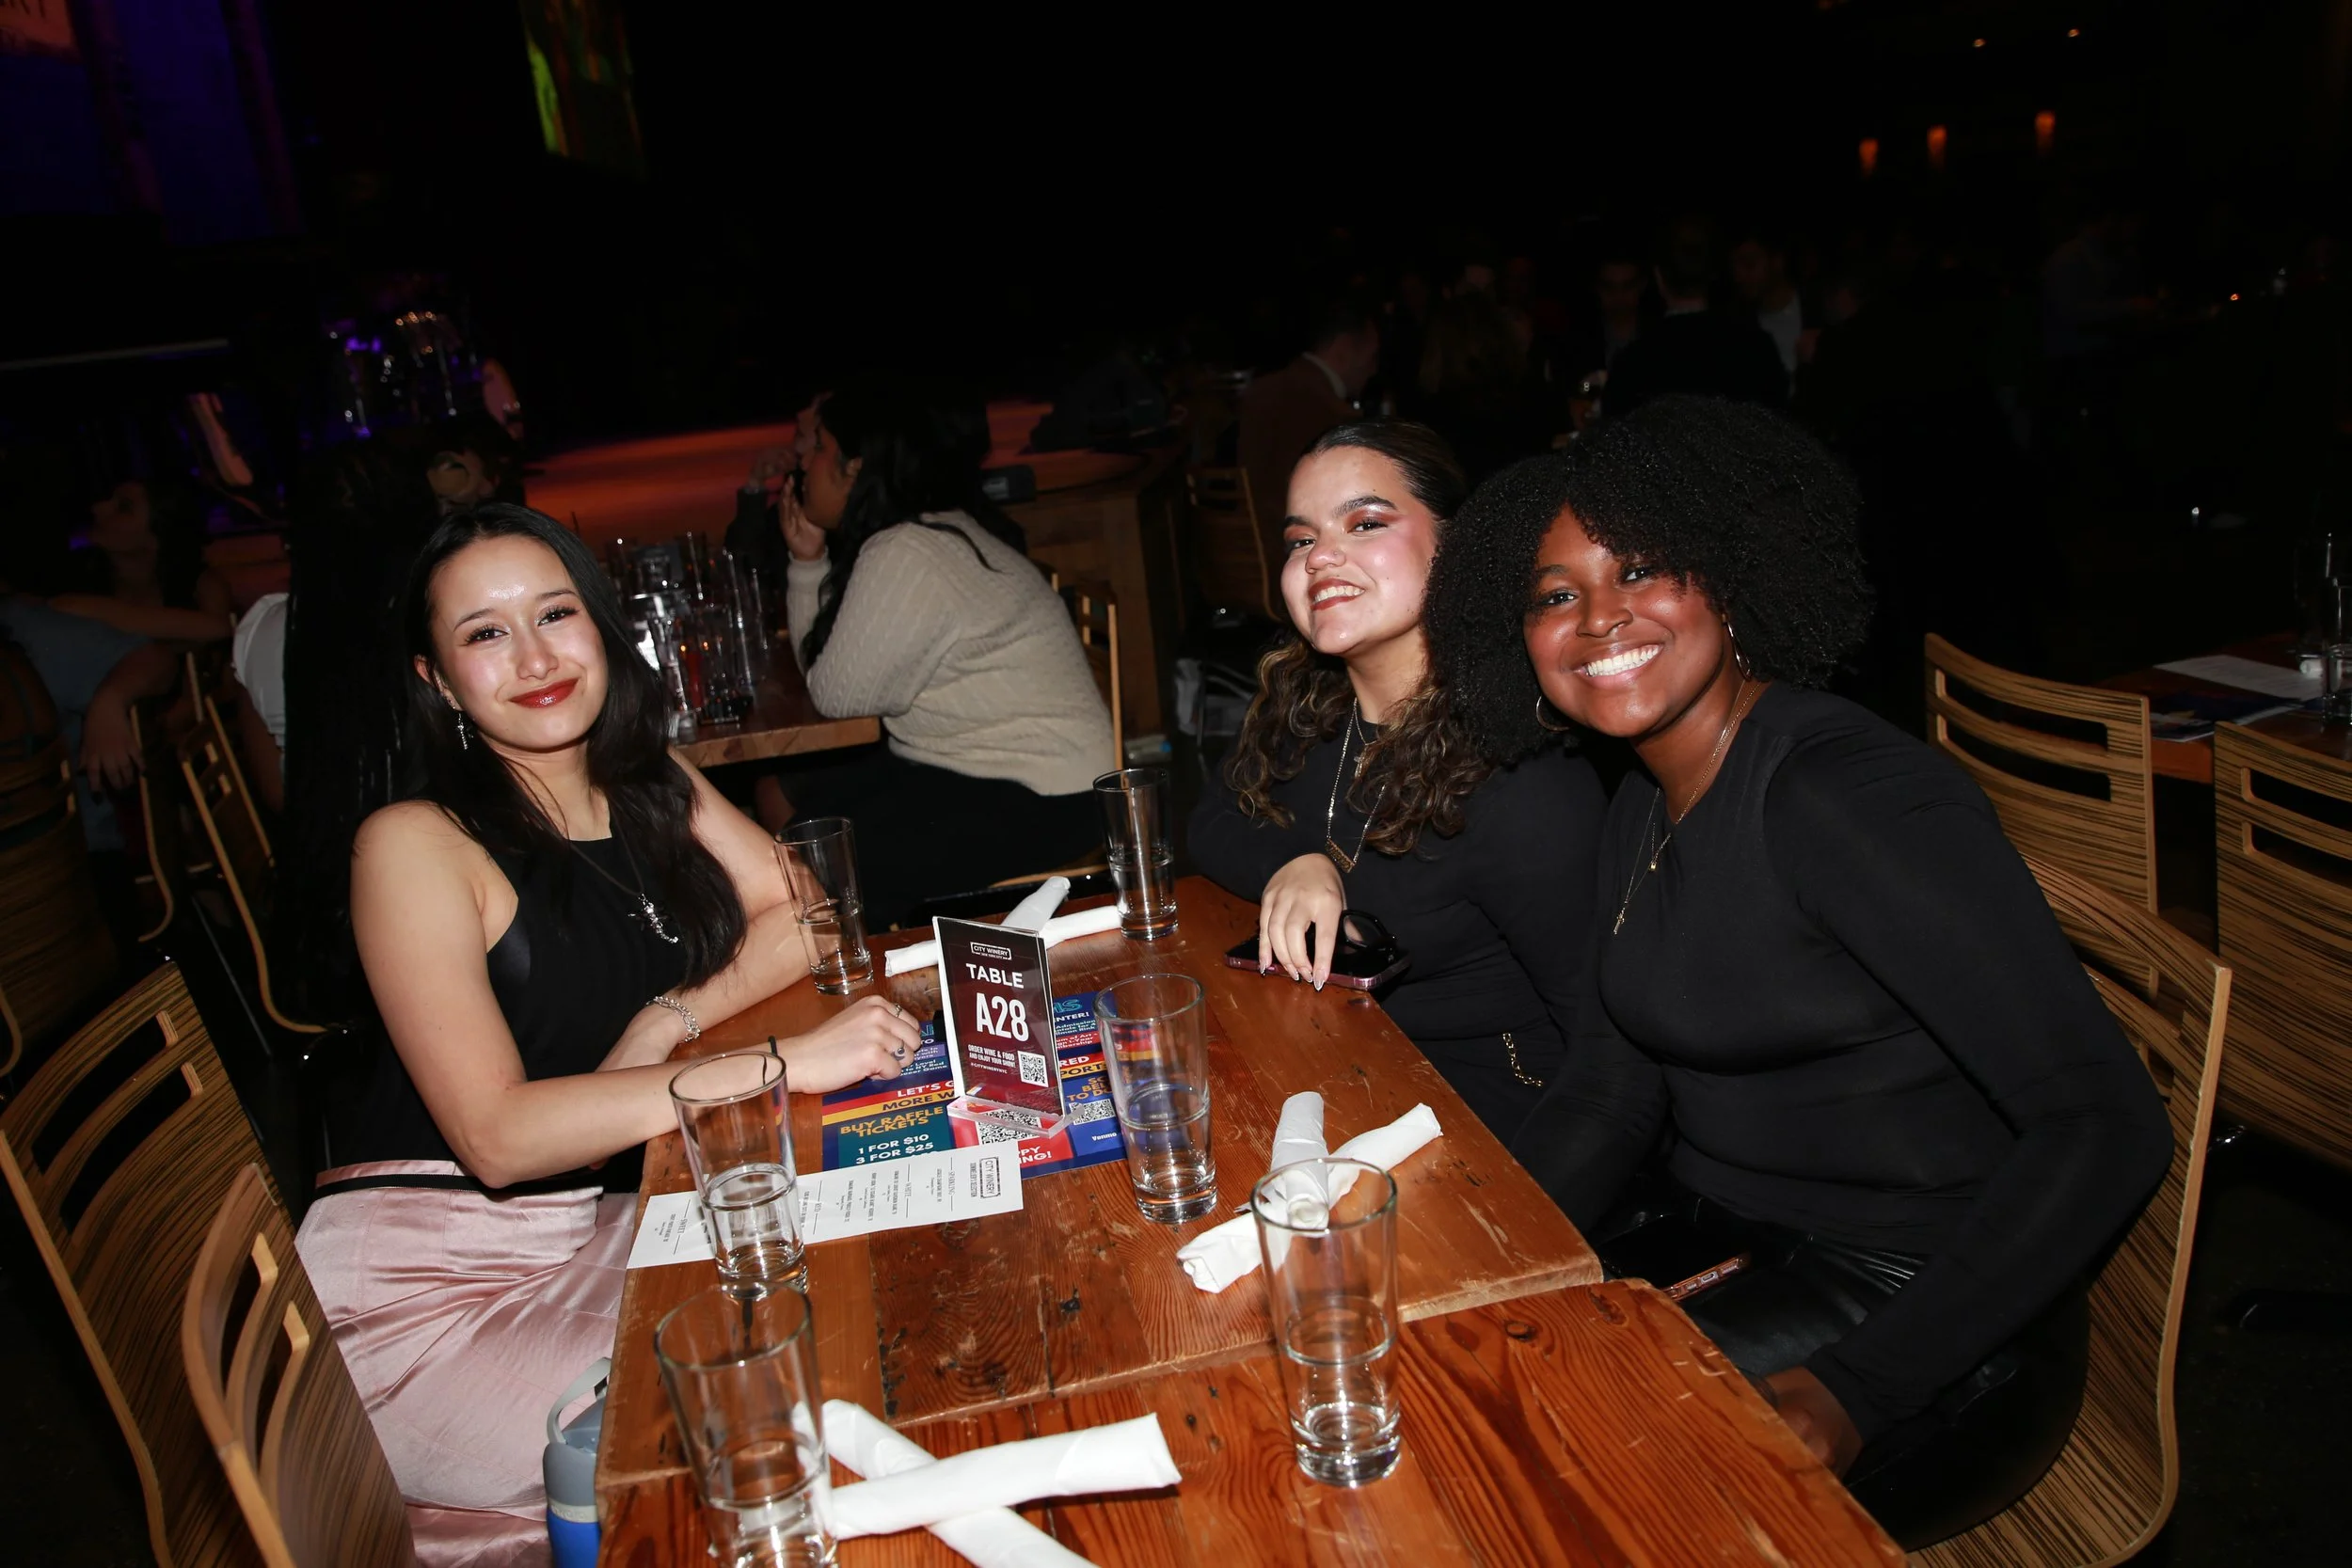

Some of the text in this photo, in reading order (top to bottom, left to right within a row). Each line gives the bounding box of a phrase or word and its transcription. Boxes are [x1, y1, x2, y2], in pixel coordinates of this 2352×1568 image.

[987, 947, 1009, 956] WINERY
[965, 962, 1025, 989] TABLE
[977, 992, 1029, 1042] A28
[1055, 1011, 1089, 1022] NTER!
[1056, 1020, 1096, 1029] Admission
[968, 1044, 984, 1054] ORDER
[983, 1047, 997, 1056] WINE
[1002, 1052, 1015, 1061] FOOD
[978, 1053, 991, 1062] ENJOY
[991, 1056, 1002, 1065] YOUR
[897, 1083, 941, 1098] LET'S
[1059, 1055, 1089, 1068] RED
[882, 1093, 933, 1111] MORE
[1066, 1092, 1089, 1101] TO
[840, 1106, 944, 1134] BUY RAFFLE
[857, 1117, 930, 1137] TICKETS
[868, 1140, 899, 1152] FOR
[903, 1133, 930, 1145] $10
[1091, 1132, 1118, 1141] Venmo
[869, 1149, 901, 1162] FOR
[905, 1142, 934, 1154] $25
[1018, 1146, 1041, 1156] PY
[984, 1160, 993, 1195] CITY WINERY
[676, 1218, 688, 1234] SWEET
